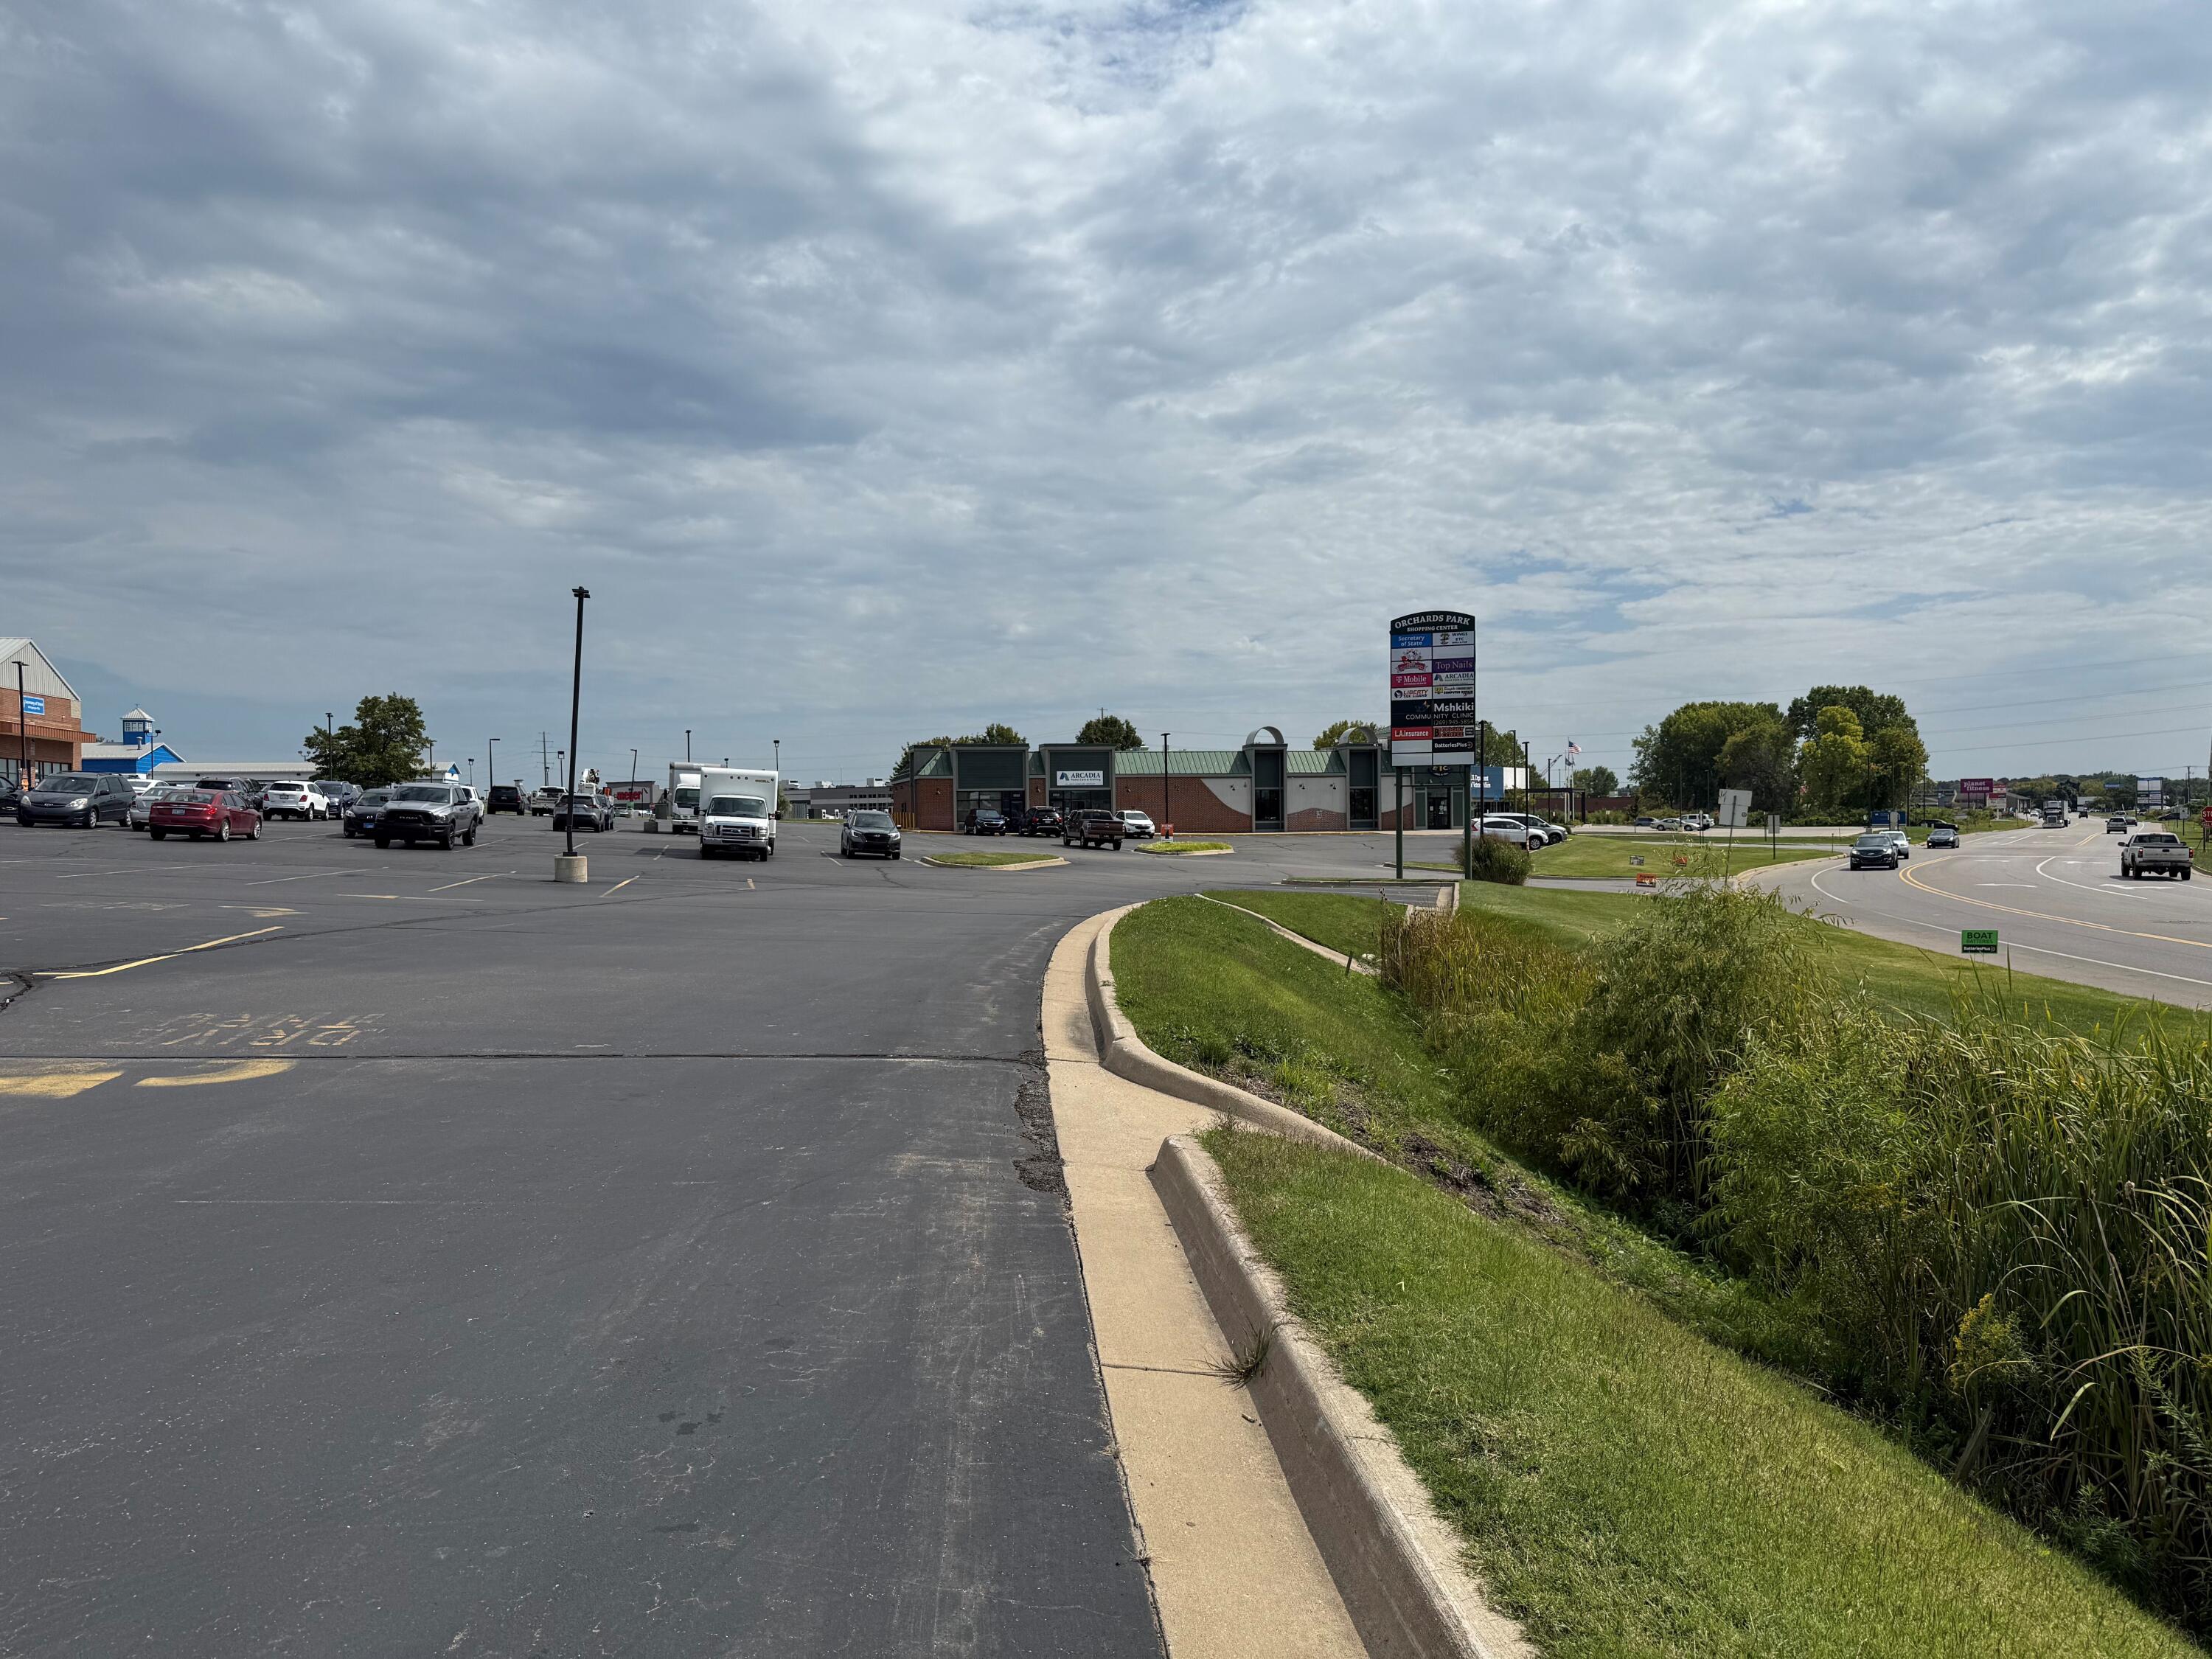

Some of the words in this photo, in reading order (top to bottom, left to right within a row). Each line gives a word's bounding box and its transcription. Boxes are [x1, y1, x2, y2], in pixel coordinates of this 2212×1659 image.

[1395, 615, 1444, 629] ORCHARDS
[1446, 615, 1471, 625] PARK
[1436, 661, 1450, 670] Top
[1452, 660, 1473, 669] Nails
[1434, 702, 1474, 712] Mshkiki
